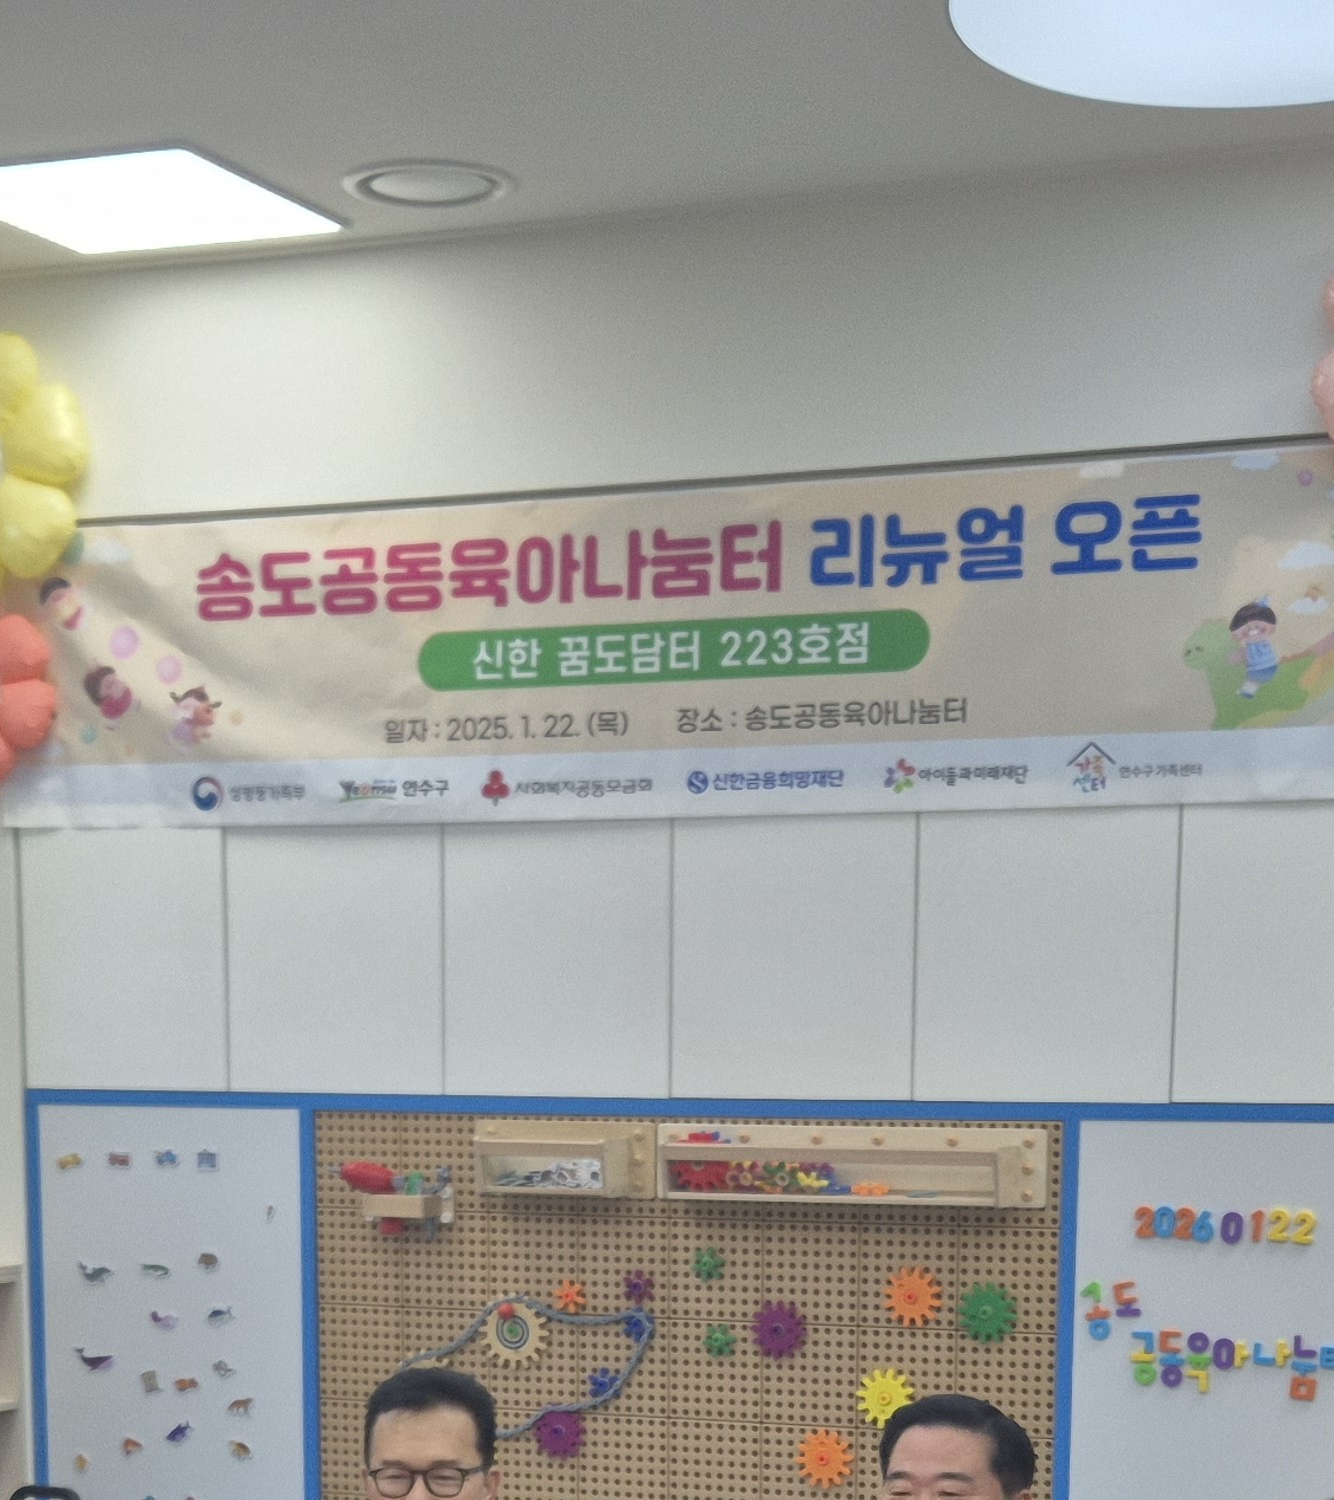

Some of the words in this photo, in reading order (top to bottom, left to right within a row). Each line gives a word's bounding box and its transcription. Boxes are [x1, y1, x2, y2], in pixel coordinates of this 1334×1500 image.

[196, 520, 782, 622] 송도공동육아나눔터
[810, 504, 1025, 588] 리뉴얼
[1050, 493, 1202, 575] 오픈
[473, 637, 543, 681] 신한
[558, 630, 702, 677] 꿈도담터
[720, 621, 870, 667] 223호점
[384, 718, 428, 744] 일자
[447, 716, 514, 742] 2025.
[544, 714, 581, 738] 22.
[588, 711, 630, 737] (목)
[676, 707, 724, 733] 장소
[744, 698, 968, 732] 송도공동육아나눔터
[402, 779, 450, 797] 연수구
[515, 778, 653, 799] 사회복지공동모금회
[713, 769, 844, 791] 신한금융희망재단
